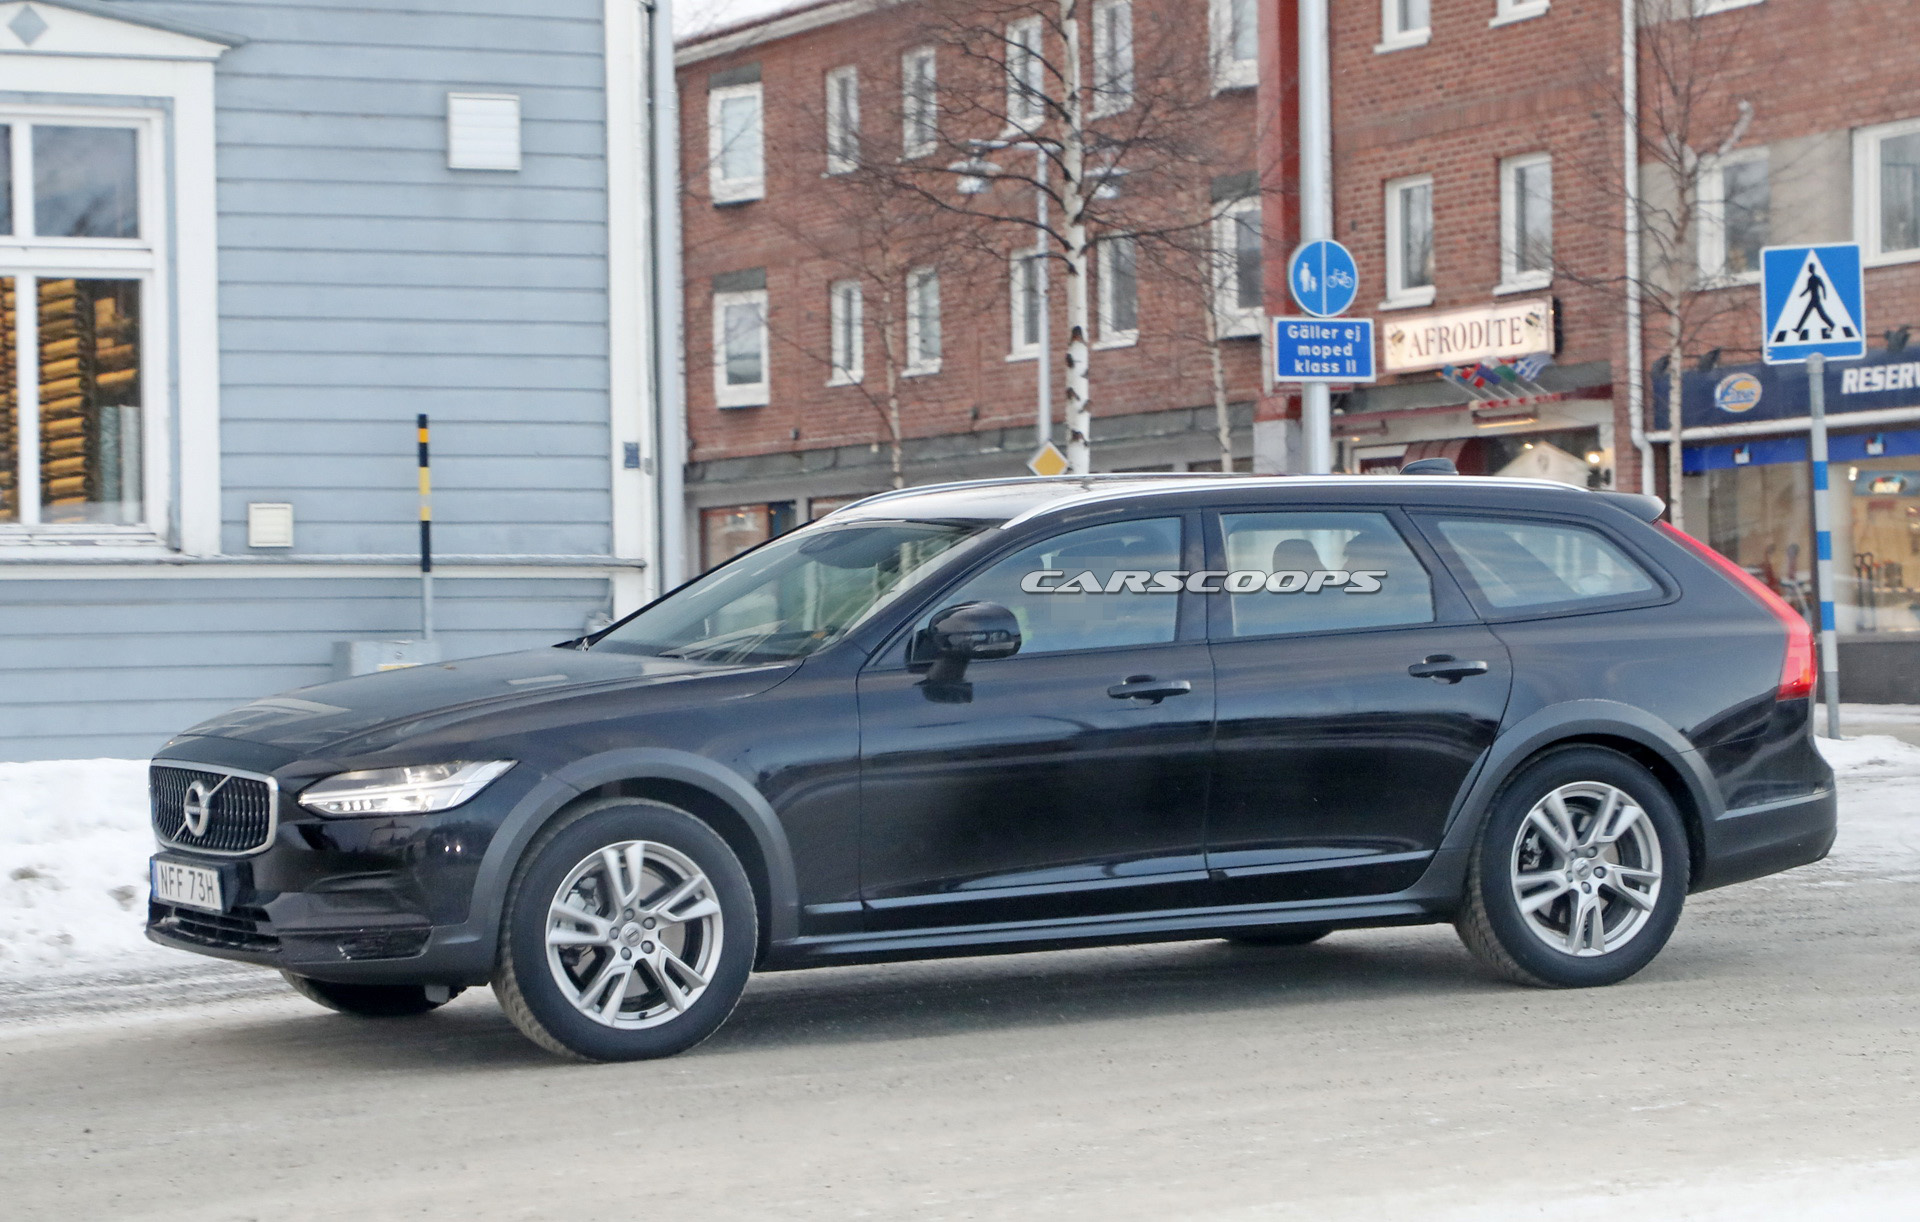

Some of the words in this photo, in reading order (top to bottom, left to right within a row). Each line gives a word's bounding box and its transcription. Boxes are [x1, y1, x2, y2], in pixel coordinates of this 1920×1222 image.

[1287, 324, 1339, 339] Gäller
[1344, 325, 1361, 342] ej
[1408, 316, 1523, 358] AFRODITE
[1297, 342, 1353, 359] moped
[1294, 359, 1340, 373] klass
[160, 865, 183, 898] NFF
[188, 870, 216, 904] 73H
